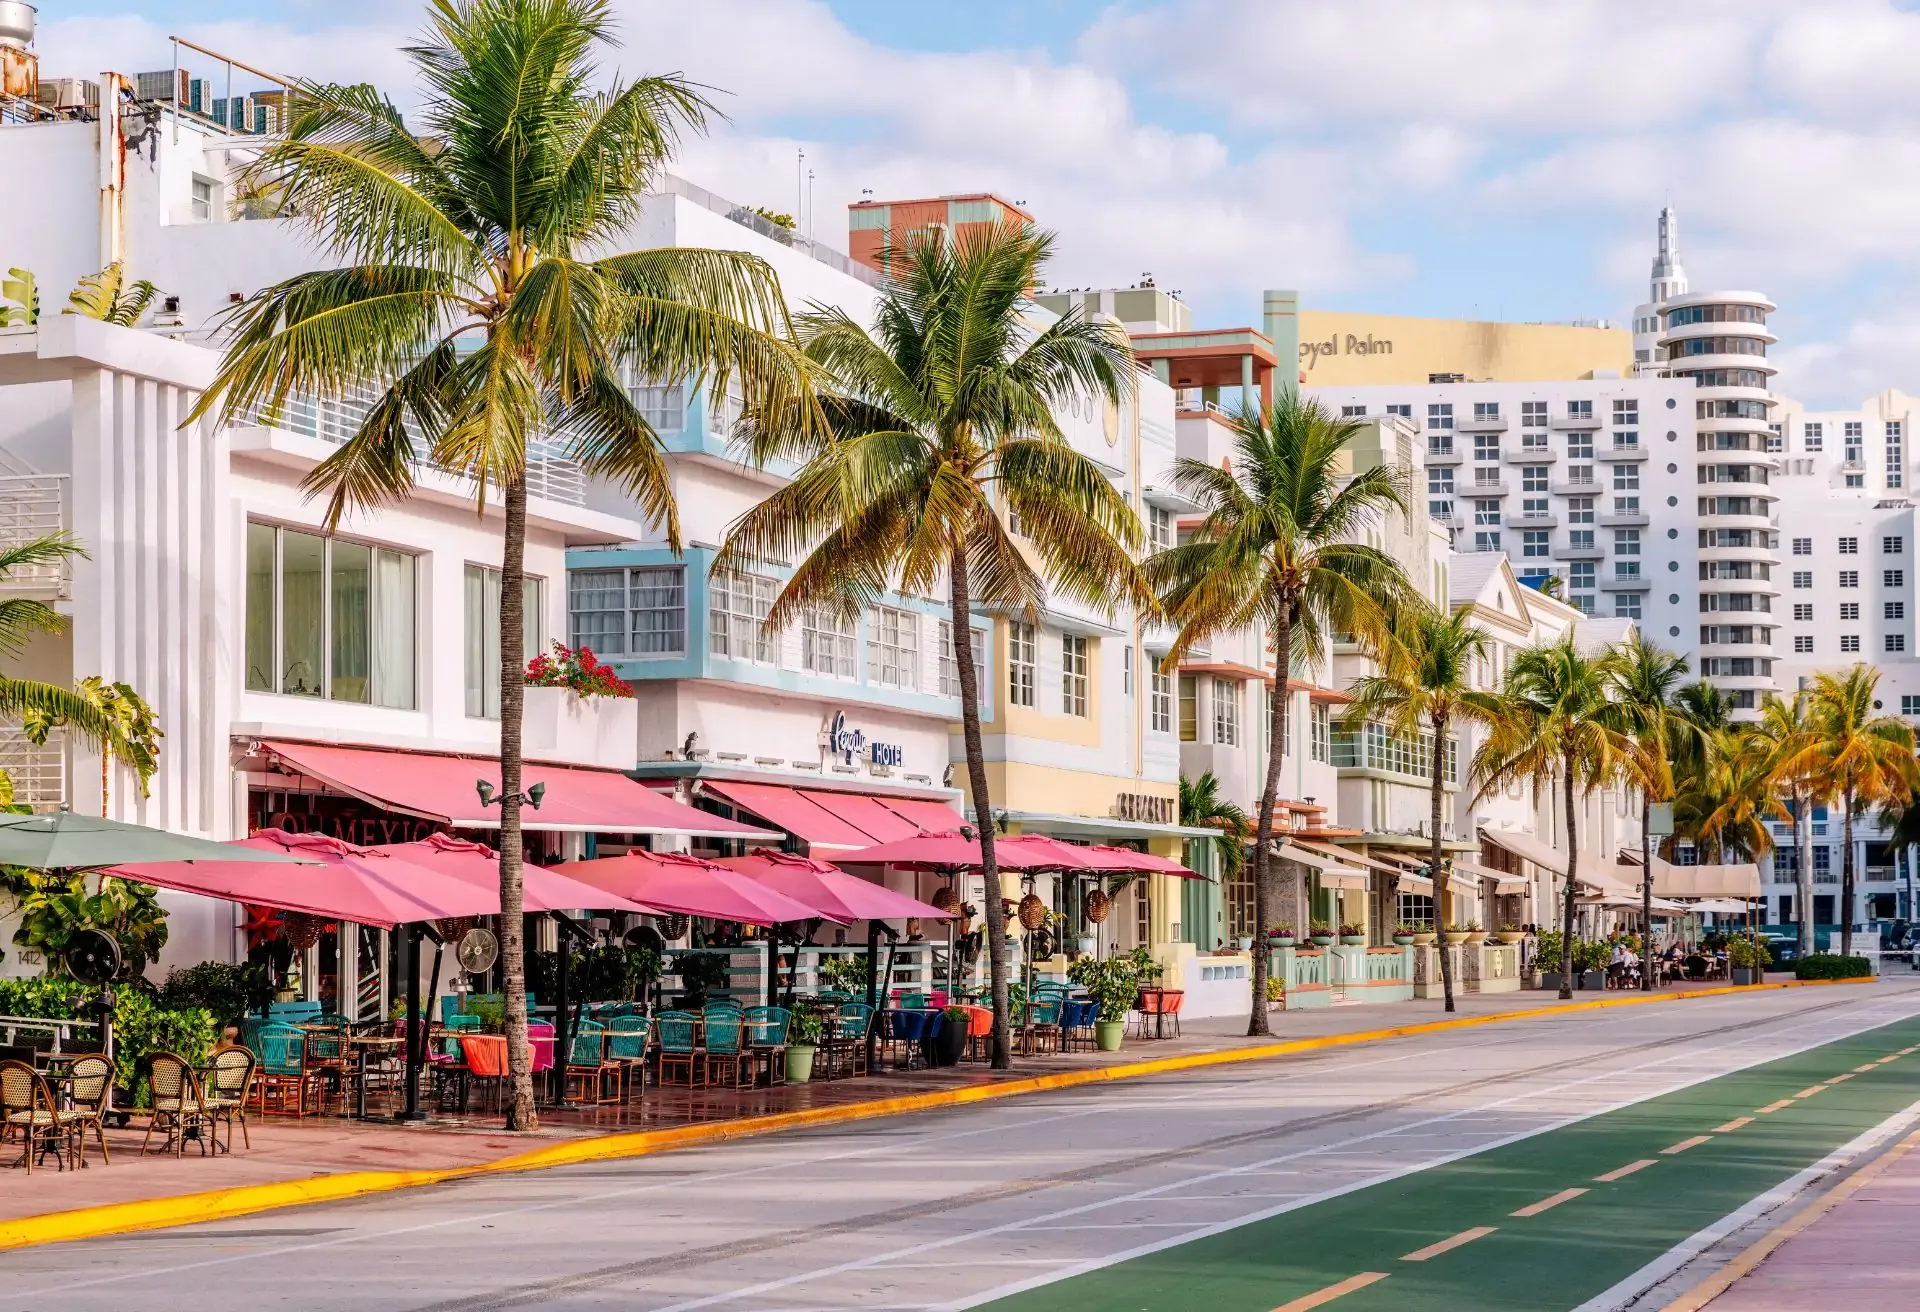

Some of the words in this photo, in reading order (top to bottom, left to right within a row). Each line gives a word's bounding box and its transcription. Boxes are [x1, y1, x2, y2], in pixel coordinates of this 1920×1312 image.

[1299, 333, 1338, 370] oyal
[1346, 333, 1393, 356] Palm
[871, 742, 905, 767] HOTEL
[17, 950, 41, 965] 1412
